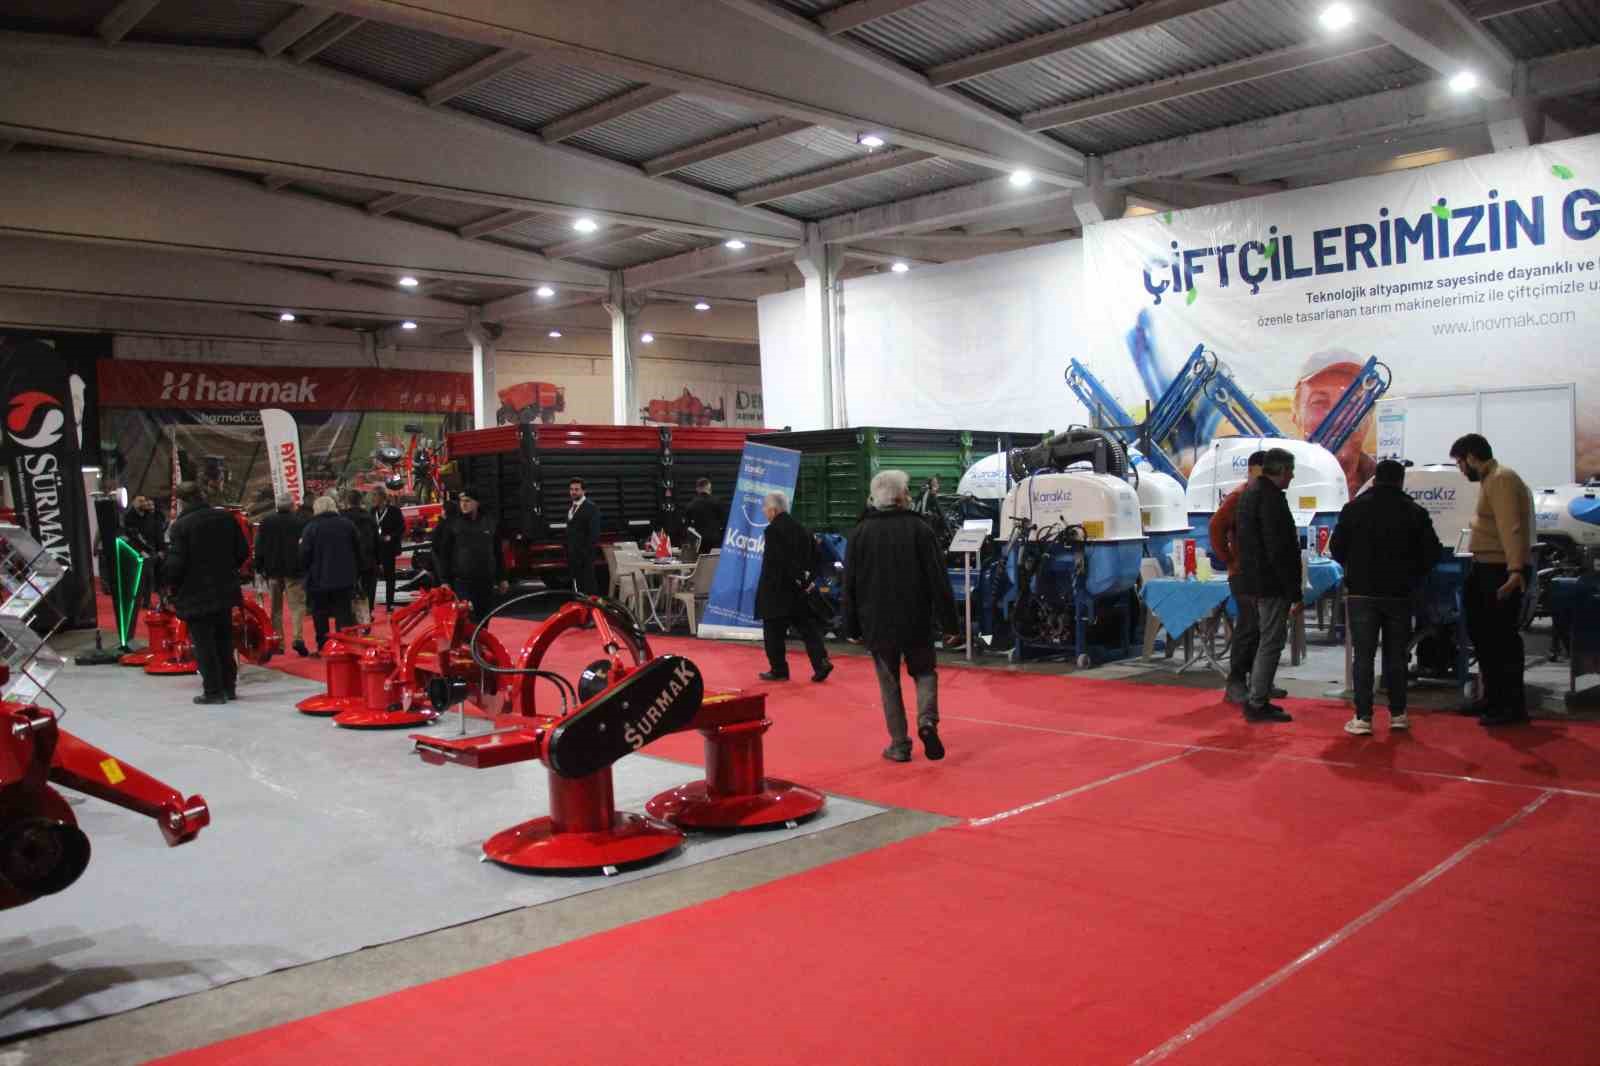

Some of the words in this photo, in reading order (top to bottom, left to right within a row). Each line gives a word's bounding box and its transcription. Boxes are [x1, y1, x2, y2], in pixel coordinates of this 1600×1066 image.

[1143, 189, 1545, 304] ÇİFTÇİLERİMİZİN
[1296, 307, 1356, 323] tasarlanan
[1395, 291, 1485, 313] makinelerimiz
[1488, 289, 1504, 302] ile
[1507, 280, 1585, 301] çiftçimizle
[1589, 279, 1600, 291] u
[1305, 287, 1367, 304] Teknolojik
[1369, 279, 1434, 296] altyapımız
[1437, 269, 1504, 290] sayesinde
[1508, 260, 1573, 281] dayanıklı
[1577, 260, 1595, 271] ve
[1432, 309, 1576, 335] www.inovmak.com
[195, 373, 319, 403] harmak
[24, 453, 73, 572] SÜRMAK
[1405, 487, 1456, 501] araKız
